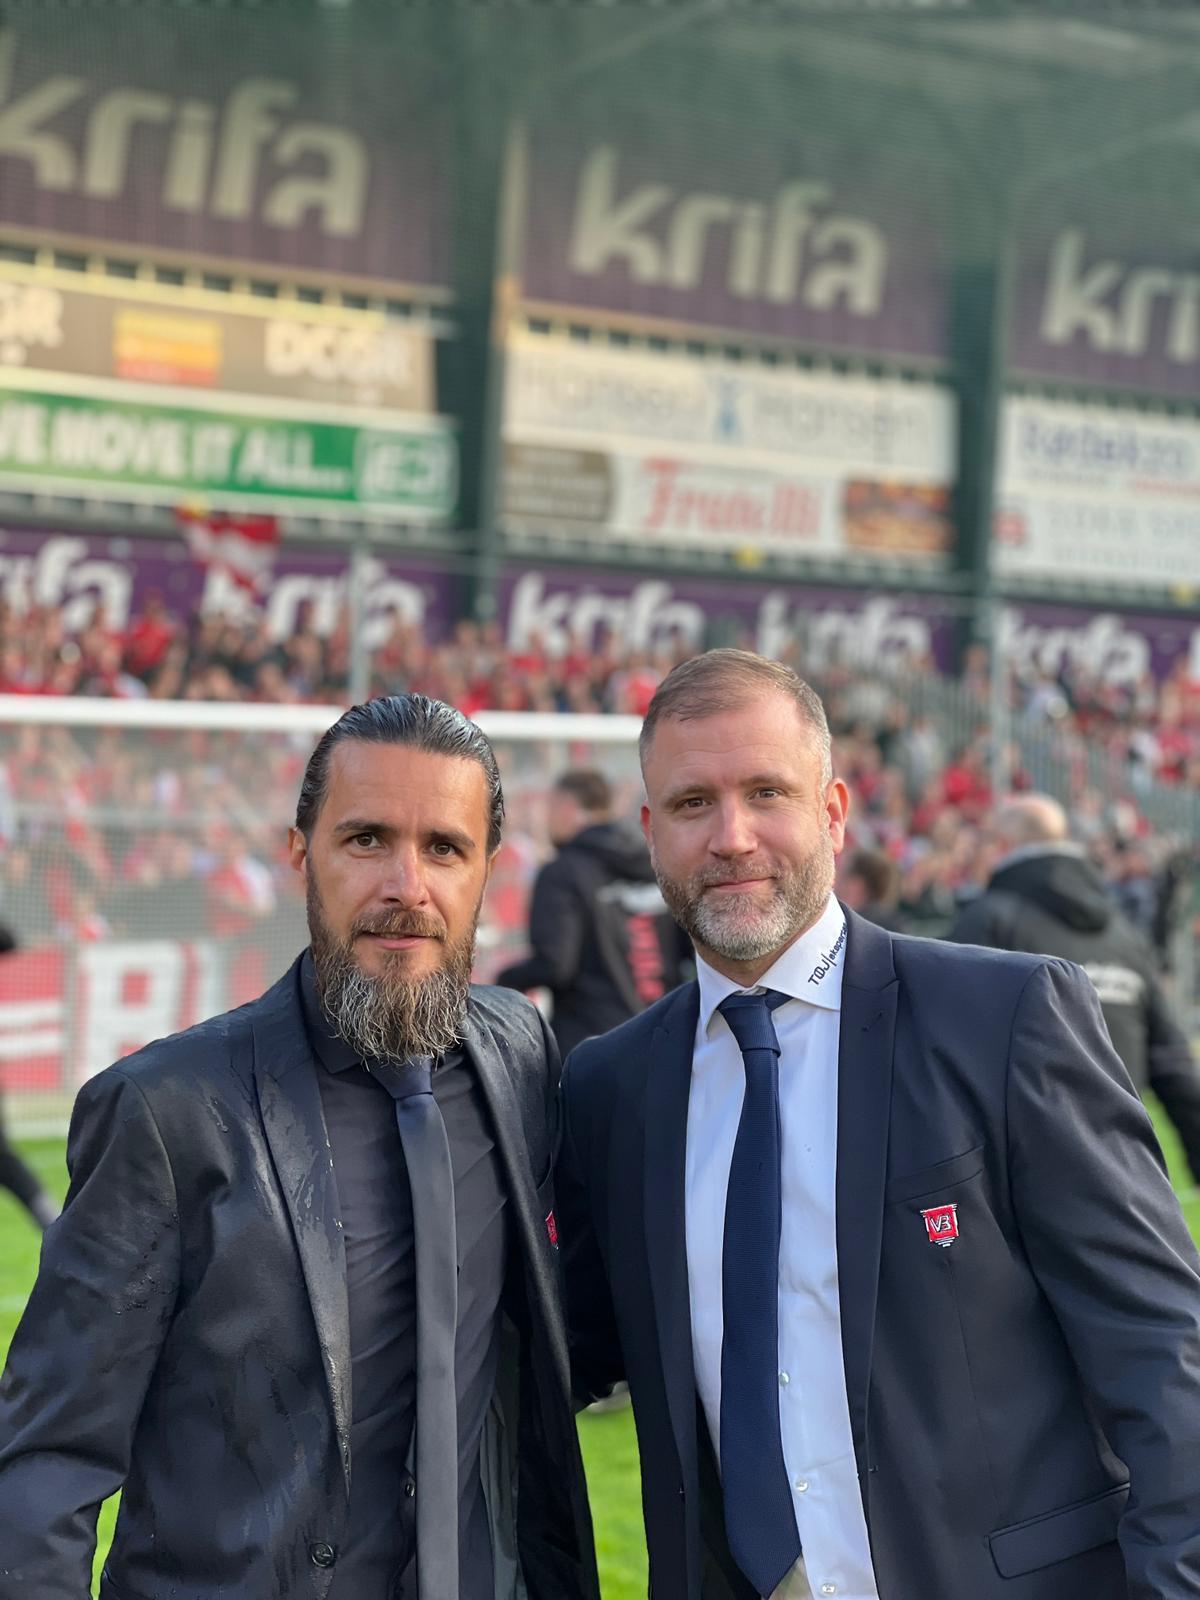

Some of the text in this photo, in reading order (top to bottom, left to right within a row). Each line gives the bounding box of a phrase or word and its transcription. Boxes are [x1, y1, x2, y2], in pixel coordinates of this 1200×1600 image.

[0, 30, 368, 238] krifa
[570, 145, 888, 318] krifa
[50, 406, 190, 480] MOVE
[192, 421, 242, 481] IT
